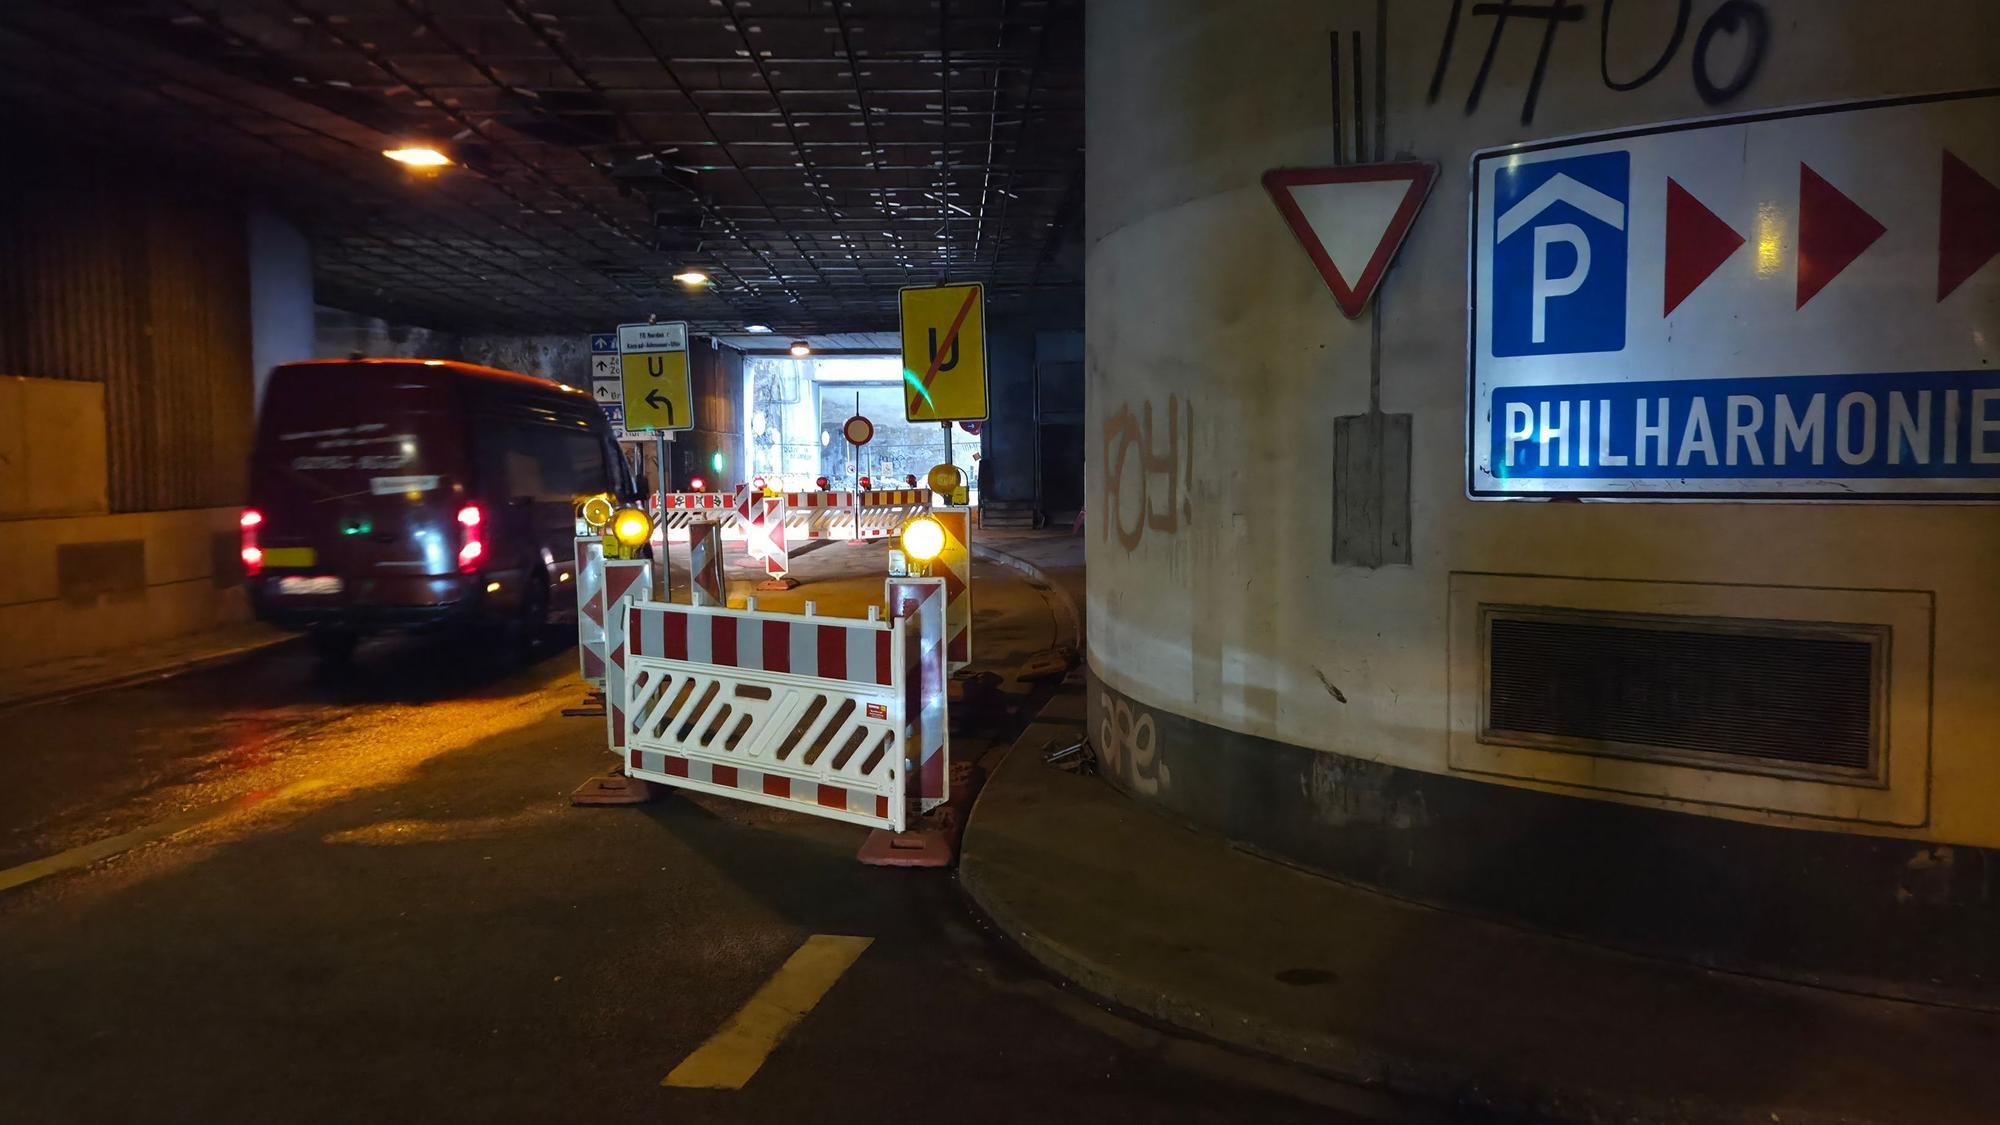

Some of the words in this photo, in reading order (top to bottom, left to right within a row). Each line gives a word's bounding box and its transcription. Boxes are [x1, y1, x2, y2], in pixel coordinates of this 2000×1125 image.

[1532, 223, 1591, 343] P
[648, 357, 663, 377] U
[1505, 388, 2000, 467] PHILHARMONIE
